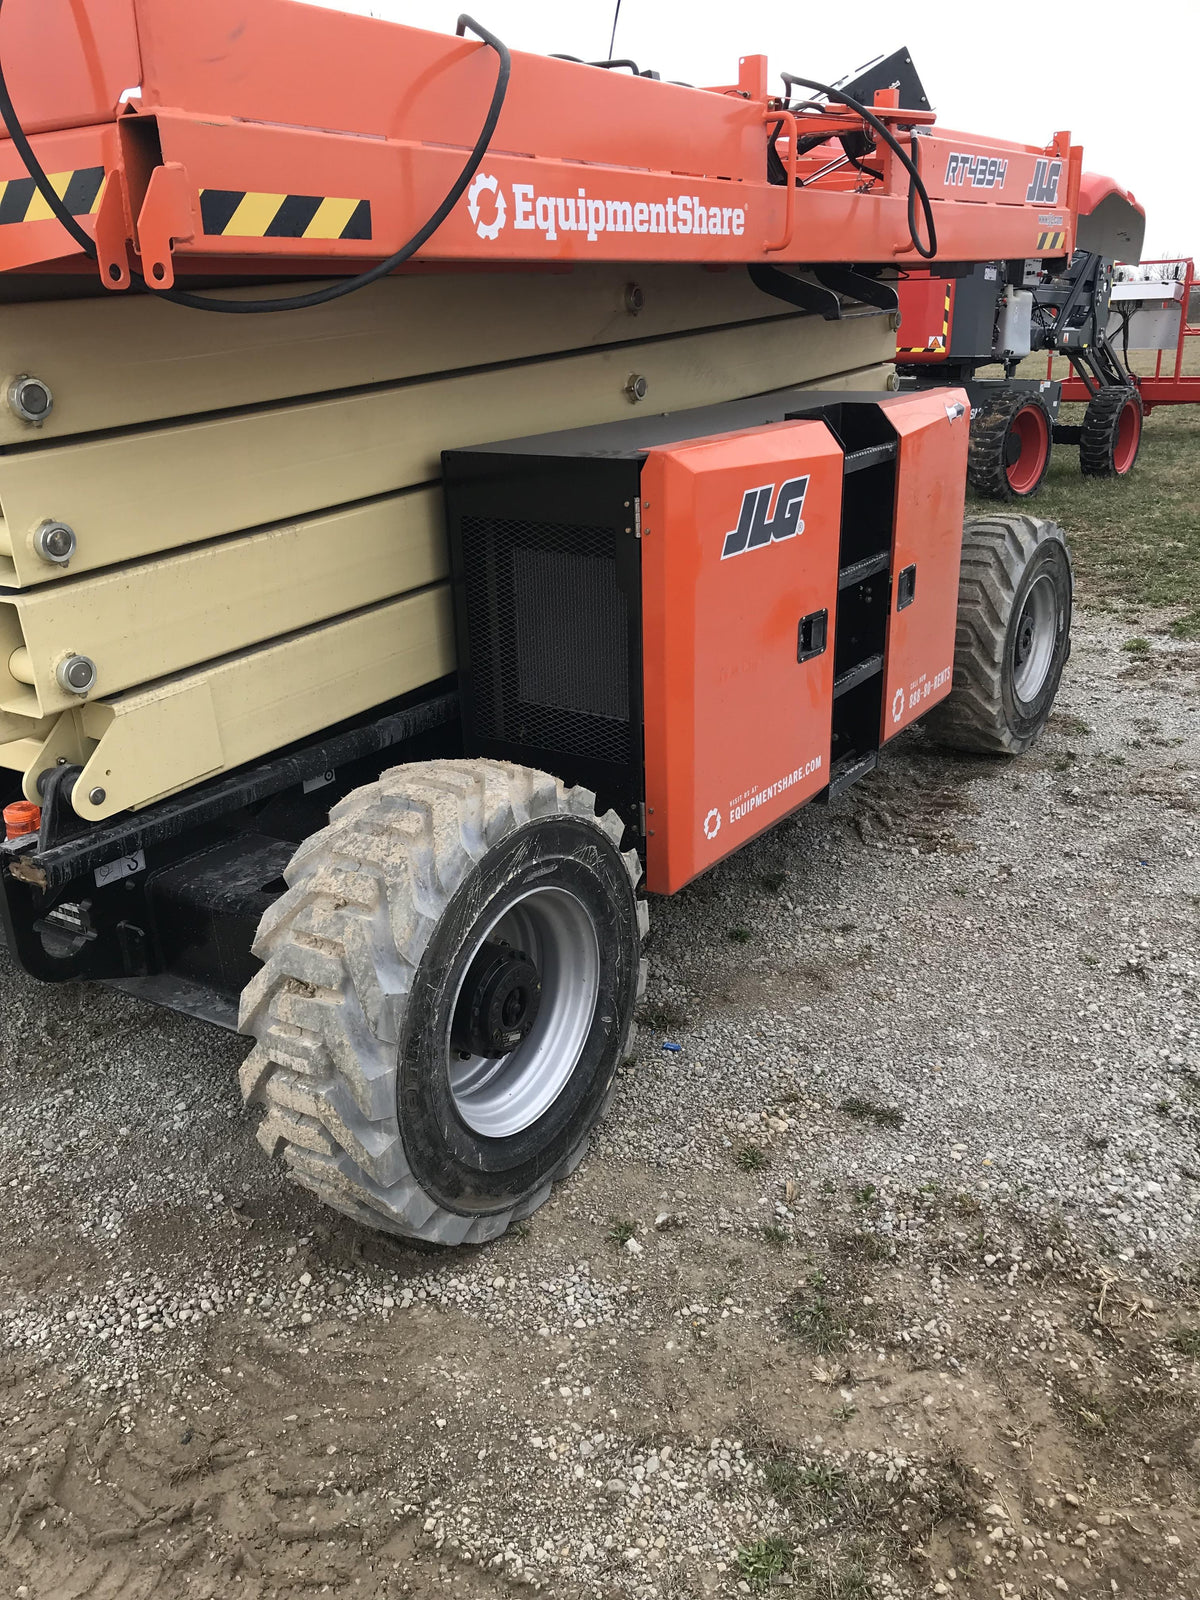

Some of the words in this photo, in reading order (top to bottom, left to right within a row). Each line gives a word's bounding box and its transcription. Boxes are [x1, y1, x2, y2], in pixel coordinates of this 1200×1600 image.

[944, 152, 1008, 189] RT4394
[1025, 158, 1062, 204] JLG
[512, 183, 745, 241] EquipmentShare
[720, 473, 811, 561] JLG
[729, 754, 822, 823] EQUIPMENTSHARE.COM
[729, 794, 743, 807] VISIT
